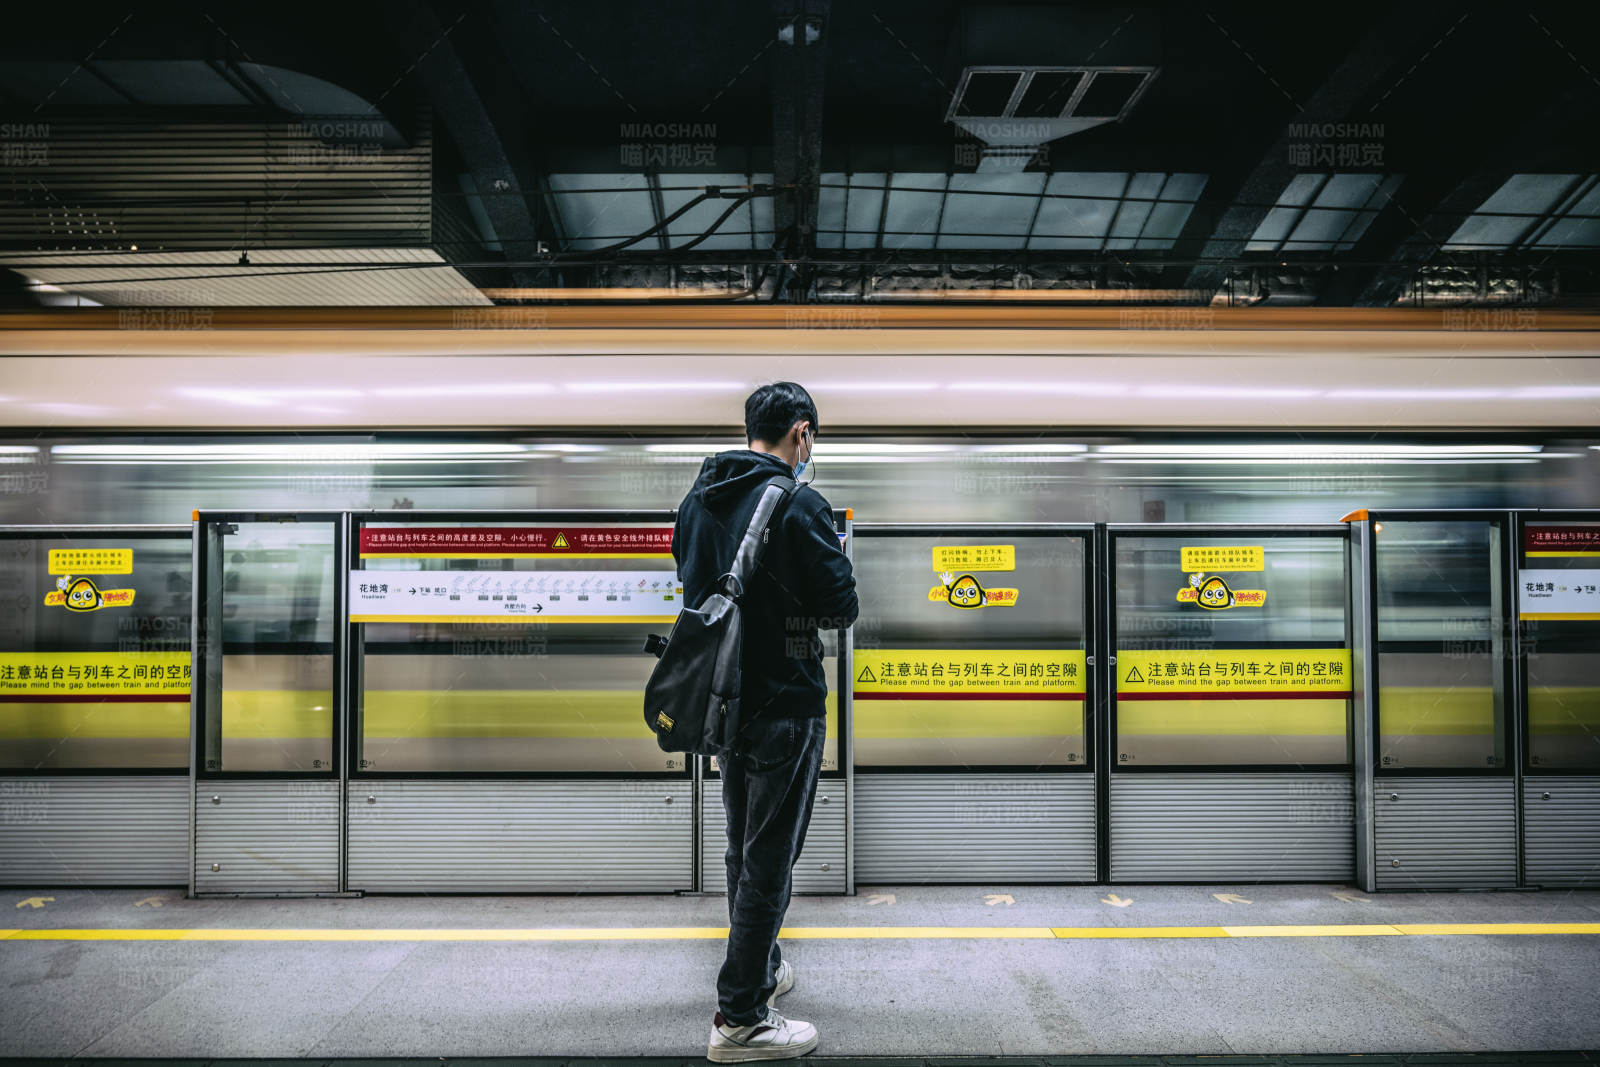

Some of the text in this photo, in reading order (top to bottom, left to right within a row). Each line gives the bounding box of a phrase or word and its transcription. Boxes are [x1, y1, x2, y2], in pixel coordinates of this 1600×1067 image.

[360, 584, 388, 593] 花地湾
[1526, 583, 1554, 592] 花地湾
[880, 662, 1077, 677] 注意站台与列车之间的空隙
[1148, 662, 1343, 677] 注意站台与列车之间的空隙
[1043, 679, 1077, 688] platform.
[1309, 678, 1343, 687] platform.
